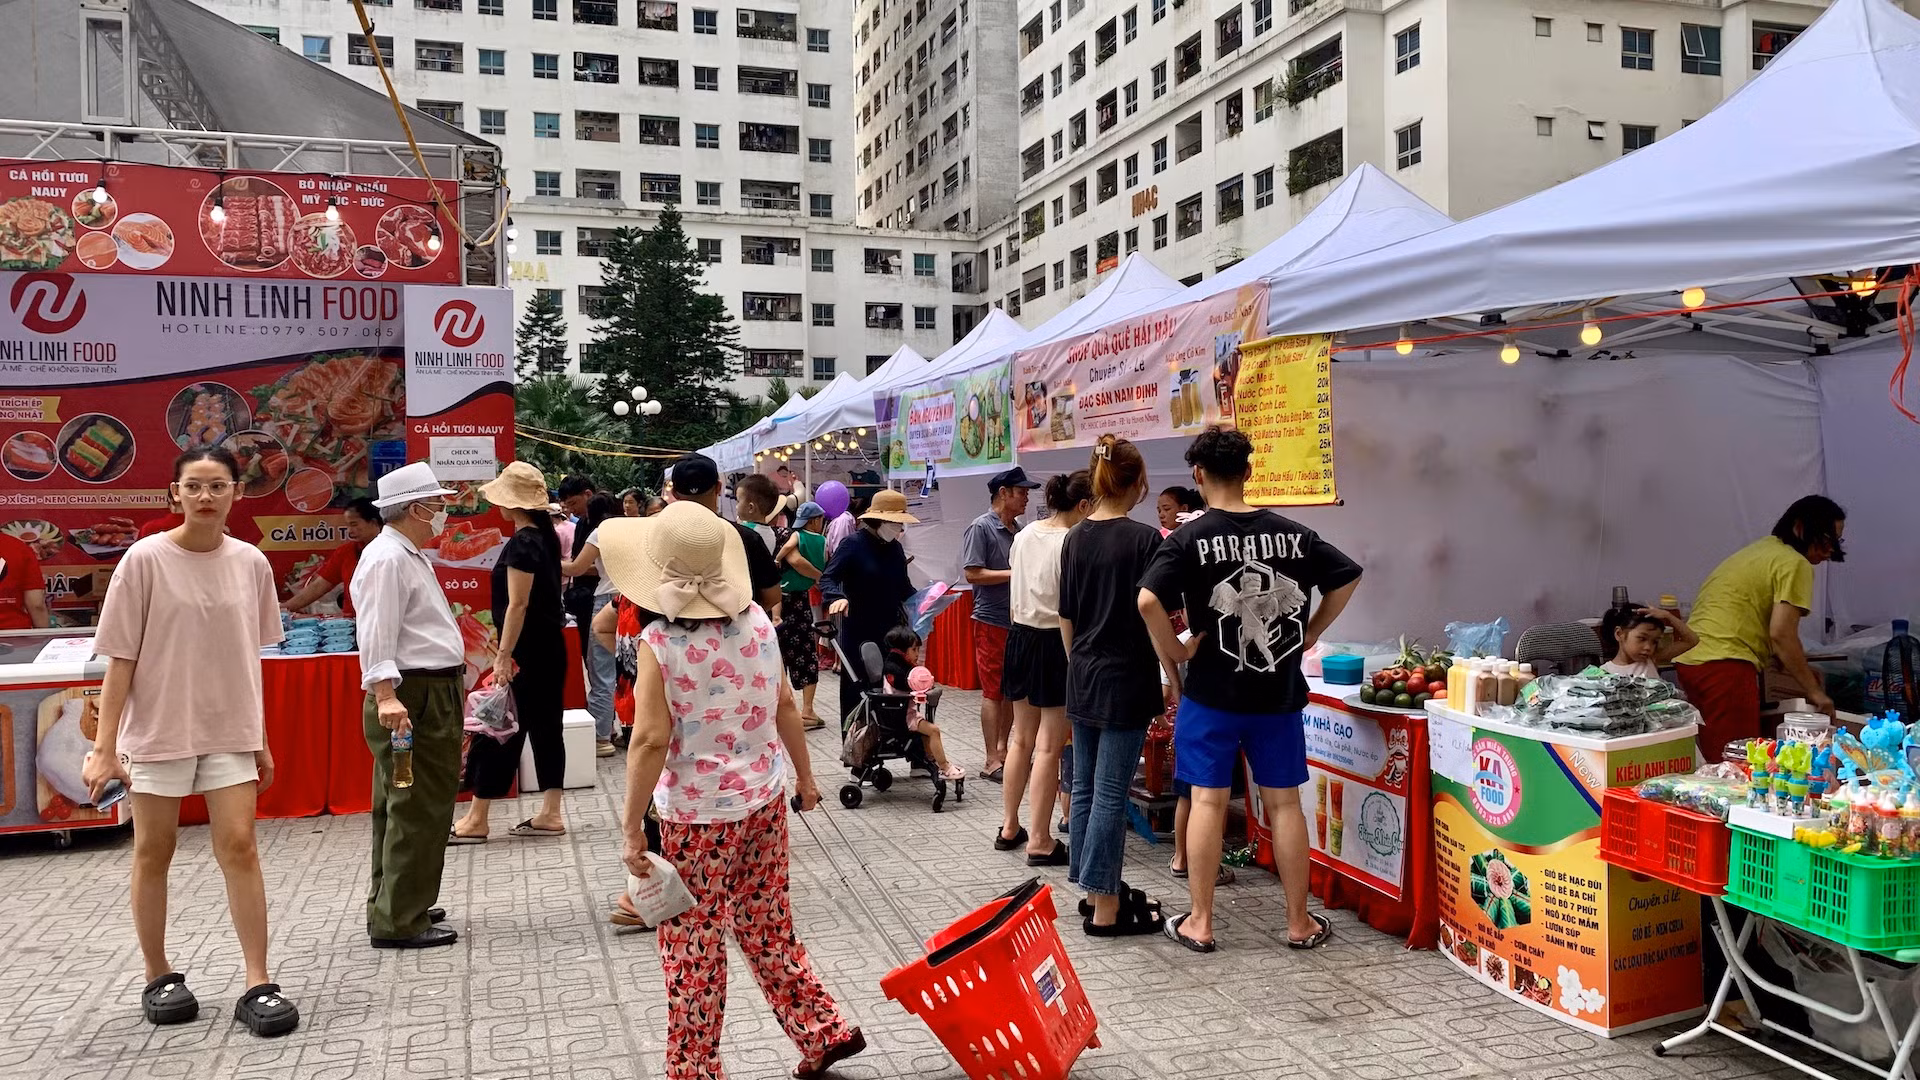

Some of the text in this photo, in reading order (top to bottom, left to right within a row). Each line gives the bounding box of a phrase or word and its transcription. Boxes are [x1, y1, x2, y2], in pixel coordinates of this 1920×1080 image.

[9, 170, 29, 181] CÁ
[59, 172, 89, 184] TƯƠI
[31, 187, 68, 198] NAUY
[298, 178, 316, 190] BÒ
[319, 180, 352, 193] NHẬP
[360, 195, 385, 207] ĐỨC
[156, 281, 398, 321] NINH LINH FOOD
[30, 341, 67, 362] LINH
[73, 342, 117, 363] FOOD
[1066, 343, 1090, 365] SHOP
[415, 351, 505, 369] NINH LINH FOOD
[1316, 361, 1329, 373] 15k
[1317, 377, 1330, 389] 20k
[1114, 386, 1134, 405] NAM
[1317, 393, 1330, 404] 20k
[1318, 408, 1330, 420] 25k
[414, 422, 430, 434] CÁ
[477, 425, 505, 435] NAUY
[1318, 423, 1330, 434] 25k
[1319, 438, 1332, 449] 25k
[44, 495, 68, 504] NEM
[68, 495, 97, 505] CHUA
[270, 523, 298, 542] CÁ
[302, 520, 335, 541] HỒI
[1196, 532, 1305, 566] PARADOX
[444, 577, 479, 590] SÒ ĐỎ
[1313, 715, 1331, 733] NHÀ
[1333, 722, 1353, 740] GẠO
[1501, 750, 1518, 778] TRUNG
[1568, 750, 1602, 790] New
[1616, 756, 1692, 783] KIỀU ANH FOOD
[1480, 785, 1505, 806] FOOD
[1569, 875, 1586, 887] NẠC
[1569, 889, 1580, 899] BA
[1628, 892, 1661, 912] Chuyên
[1545, 907, 1560, 920] NGÔ
[1570, 902, 1575, 911] 7
[1576, 904, 1598, 917] PHÚT
[1580, 945, 1596, 957] QUE
